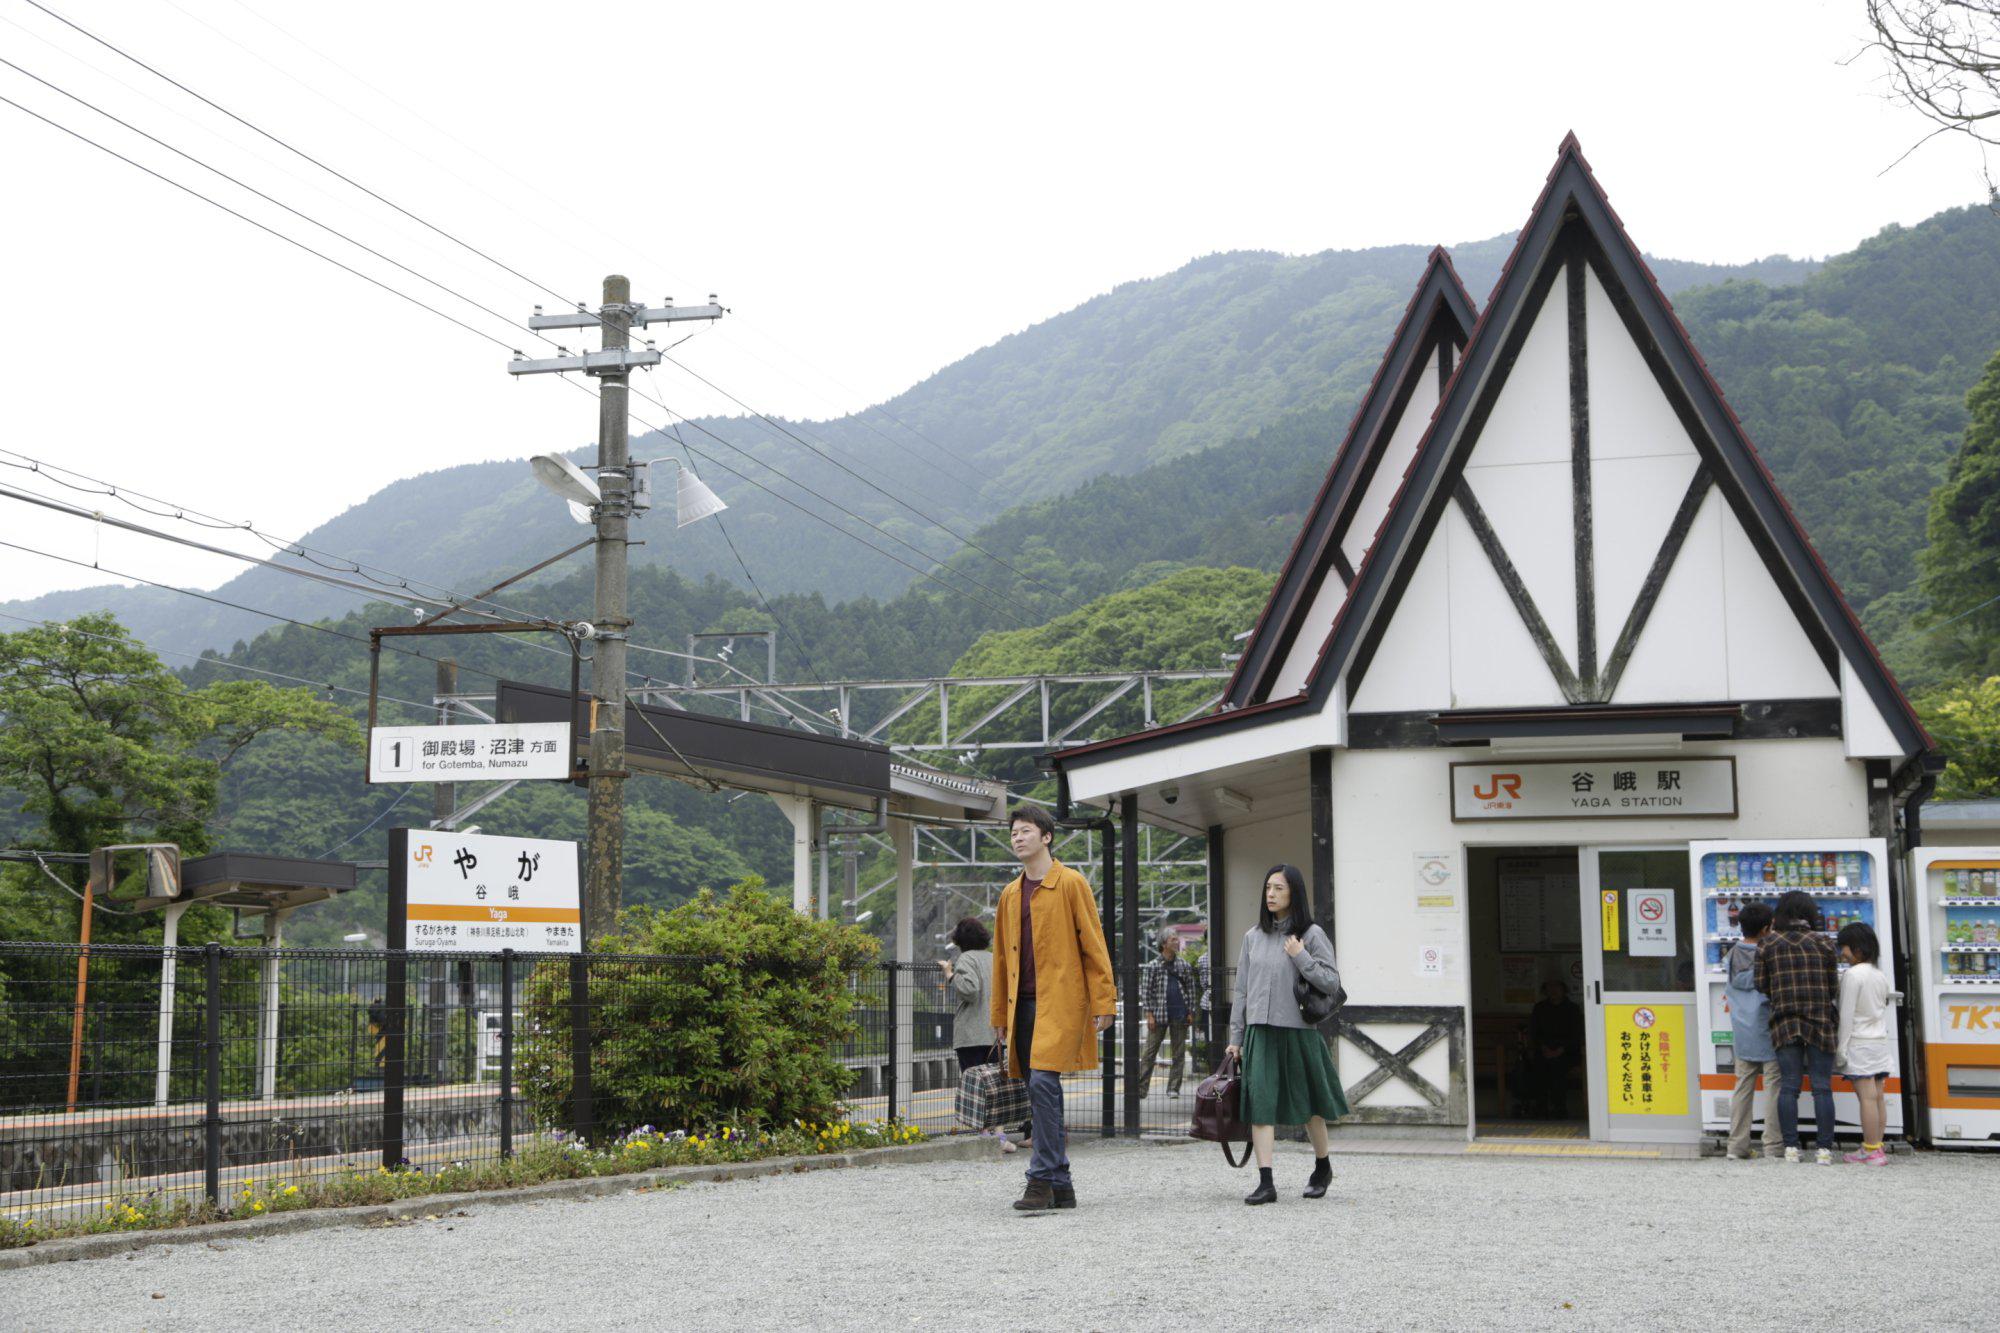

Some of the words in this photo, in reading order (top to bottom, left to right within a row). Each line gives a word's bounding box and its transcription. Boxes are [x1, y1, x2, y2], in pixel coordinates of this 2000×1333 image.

[390, 741, 401, 768] 1
[422, 761, 435, 770] for
[439, 759, 485, 770] Gotemba,
[488, 759, 528, 769] Numazu
[1473, 773, 1522, 800] JR
[1571, 798, 1611, 808] YAGA
[1621, 797, 1682, 807] STATION
[414, 845, 433, 862] JR
[489, 907, 508, 922] Yaga
[415, 924, 457, 936] するがおやま
[545, 926, 574, 937] やまきた
[546, 939, 569, 947] Yamakita
